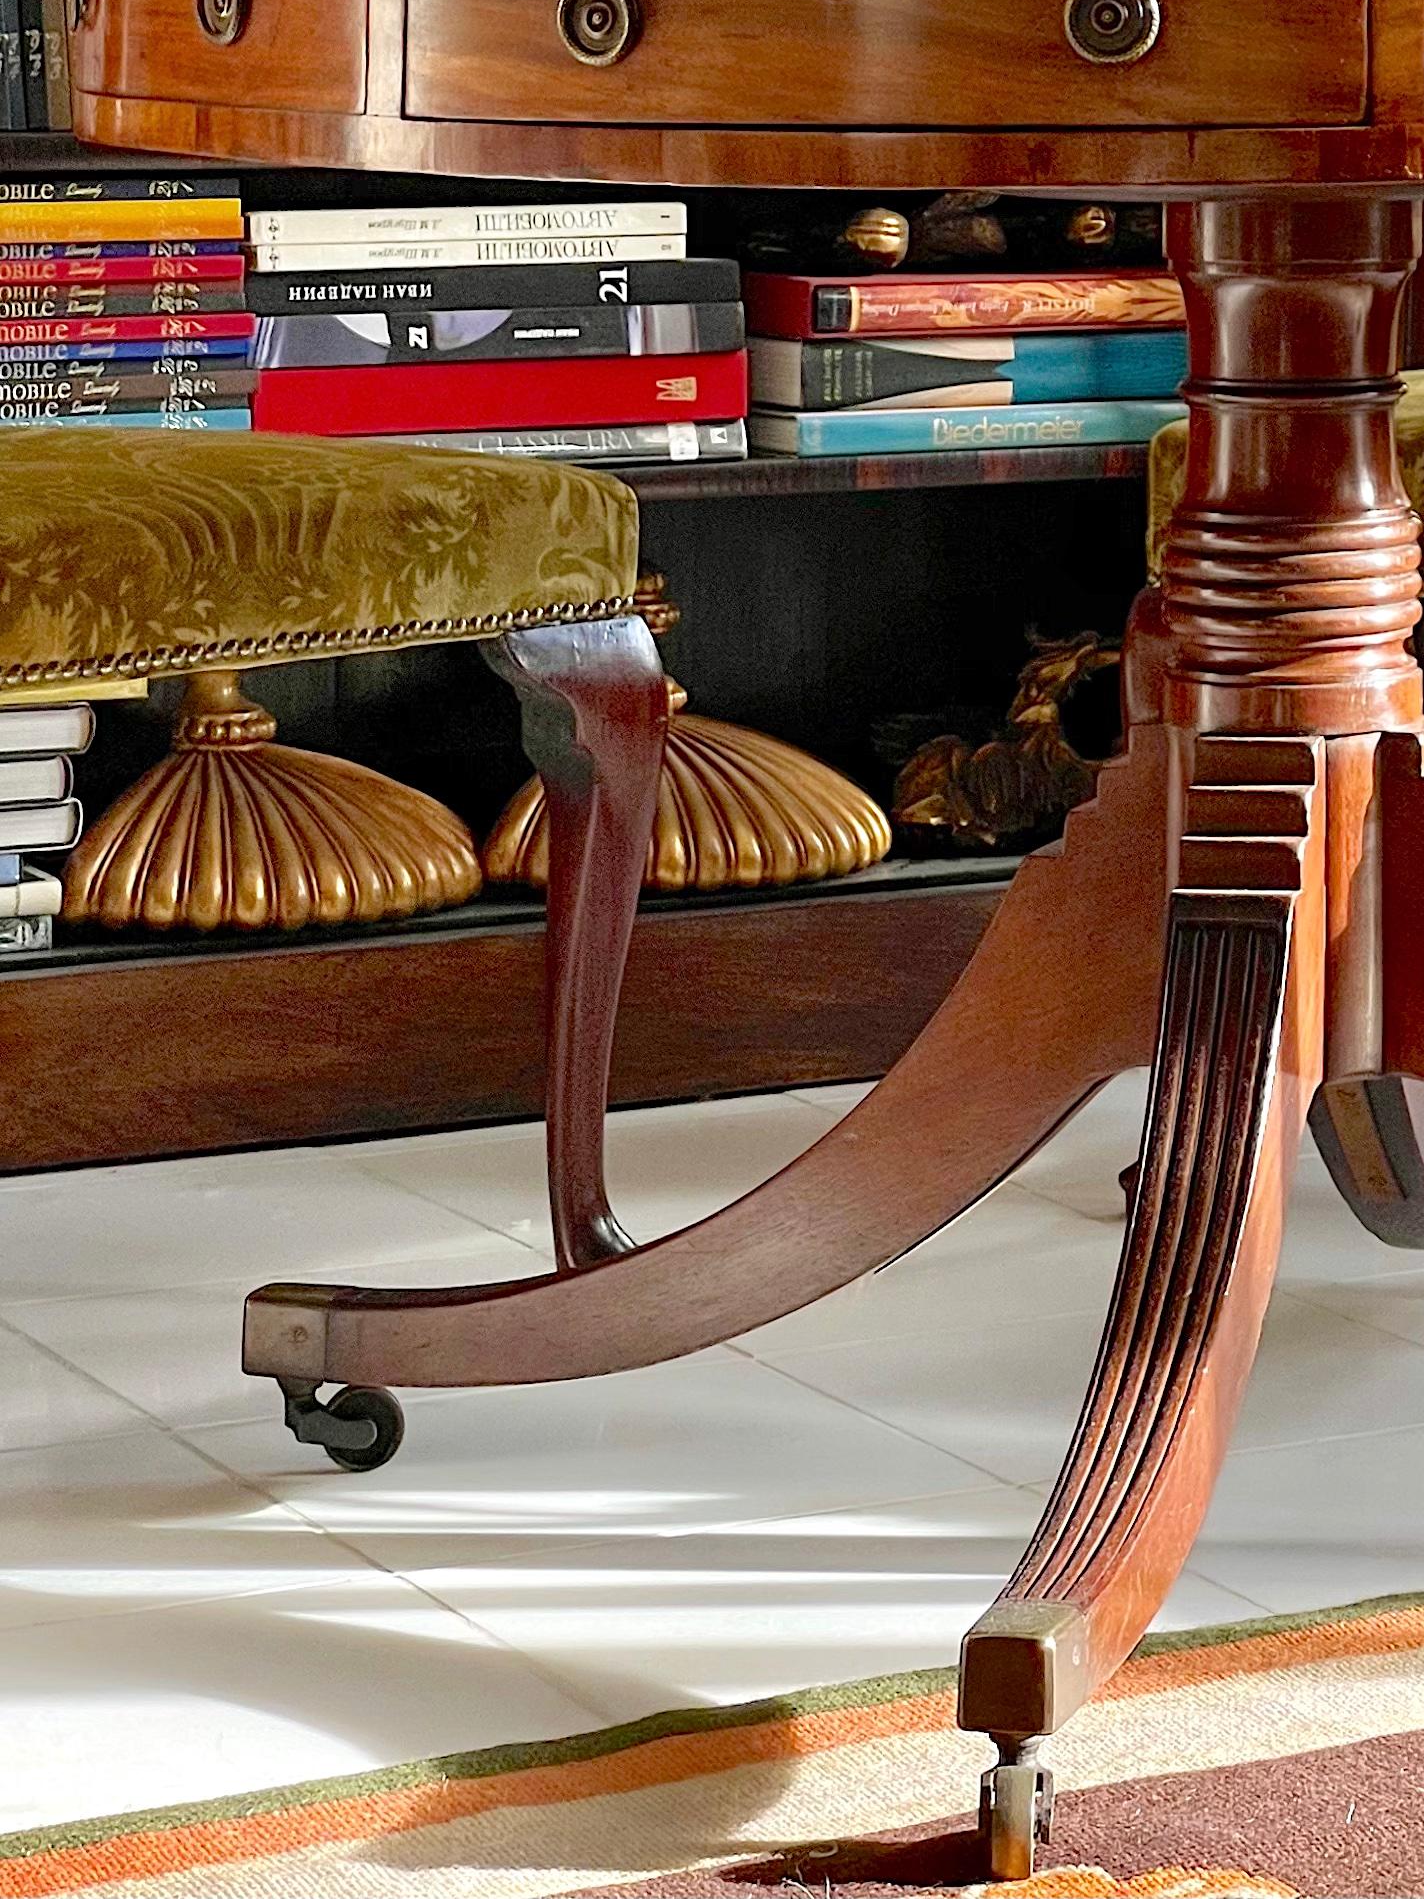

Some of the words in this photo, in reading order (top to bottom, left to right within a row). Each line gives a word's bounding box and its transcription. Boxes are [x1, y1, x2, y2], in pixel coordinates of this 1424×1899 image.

[475, 209, 619, 233] АВТОМОБИЛИ
[477, 240, 620, 260] АВТОМОБИЛИ
[288, 284, 377, 301] ПАДЕРИН
[382, 283, 433, 299] ИВАН
[599, 265, 629, 303] 21
[932, 415, 1085, 446] Biedermeier
